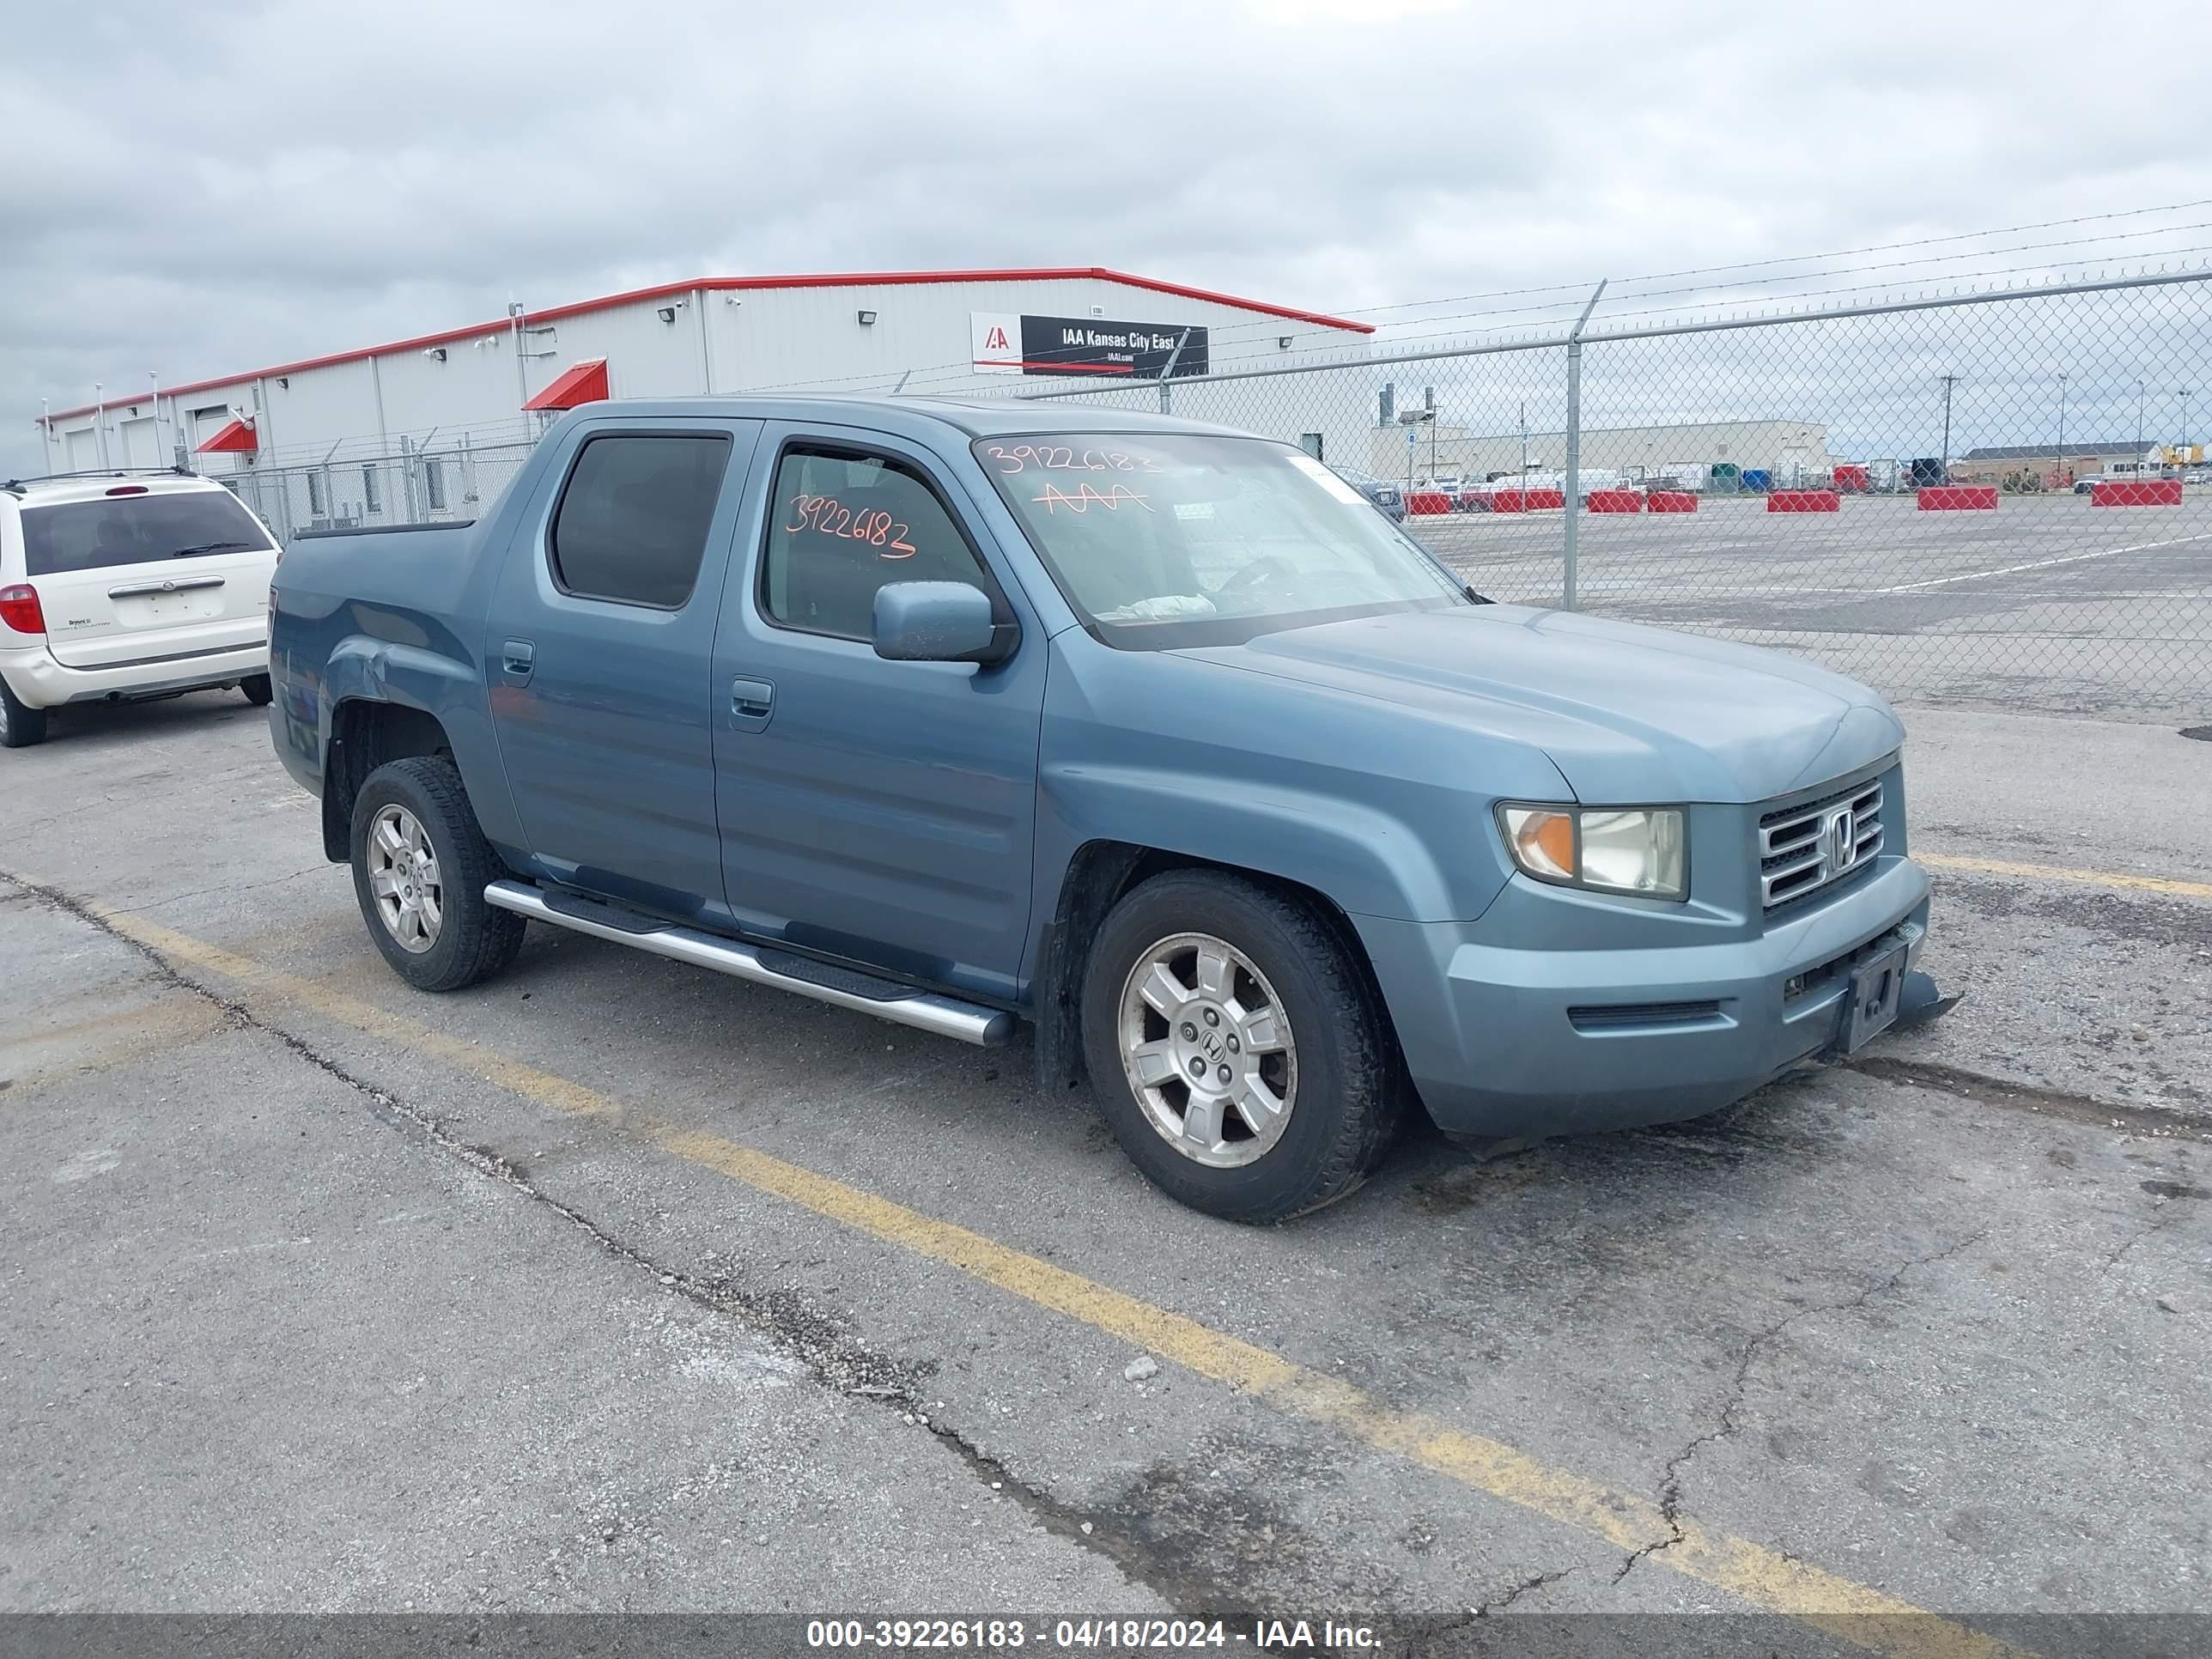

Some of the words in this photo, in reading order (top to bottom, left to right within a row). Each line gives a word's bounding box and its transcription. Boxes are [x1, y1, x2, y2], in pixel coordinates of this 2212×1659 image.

[1062, 328, 1085, 345] IAA
[1086, 330, 1127, 348] Kansas
[1129, 332, 1150, 352] City
[1152, 333, 1176, 349] East
[988, 445, 1163, 474] 39226183
[785, 494, 916, 559] 39226183
